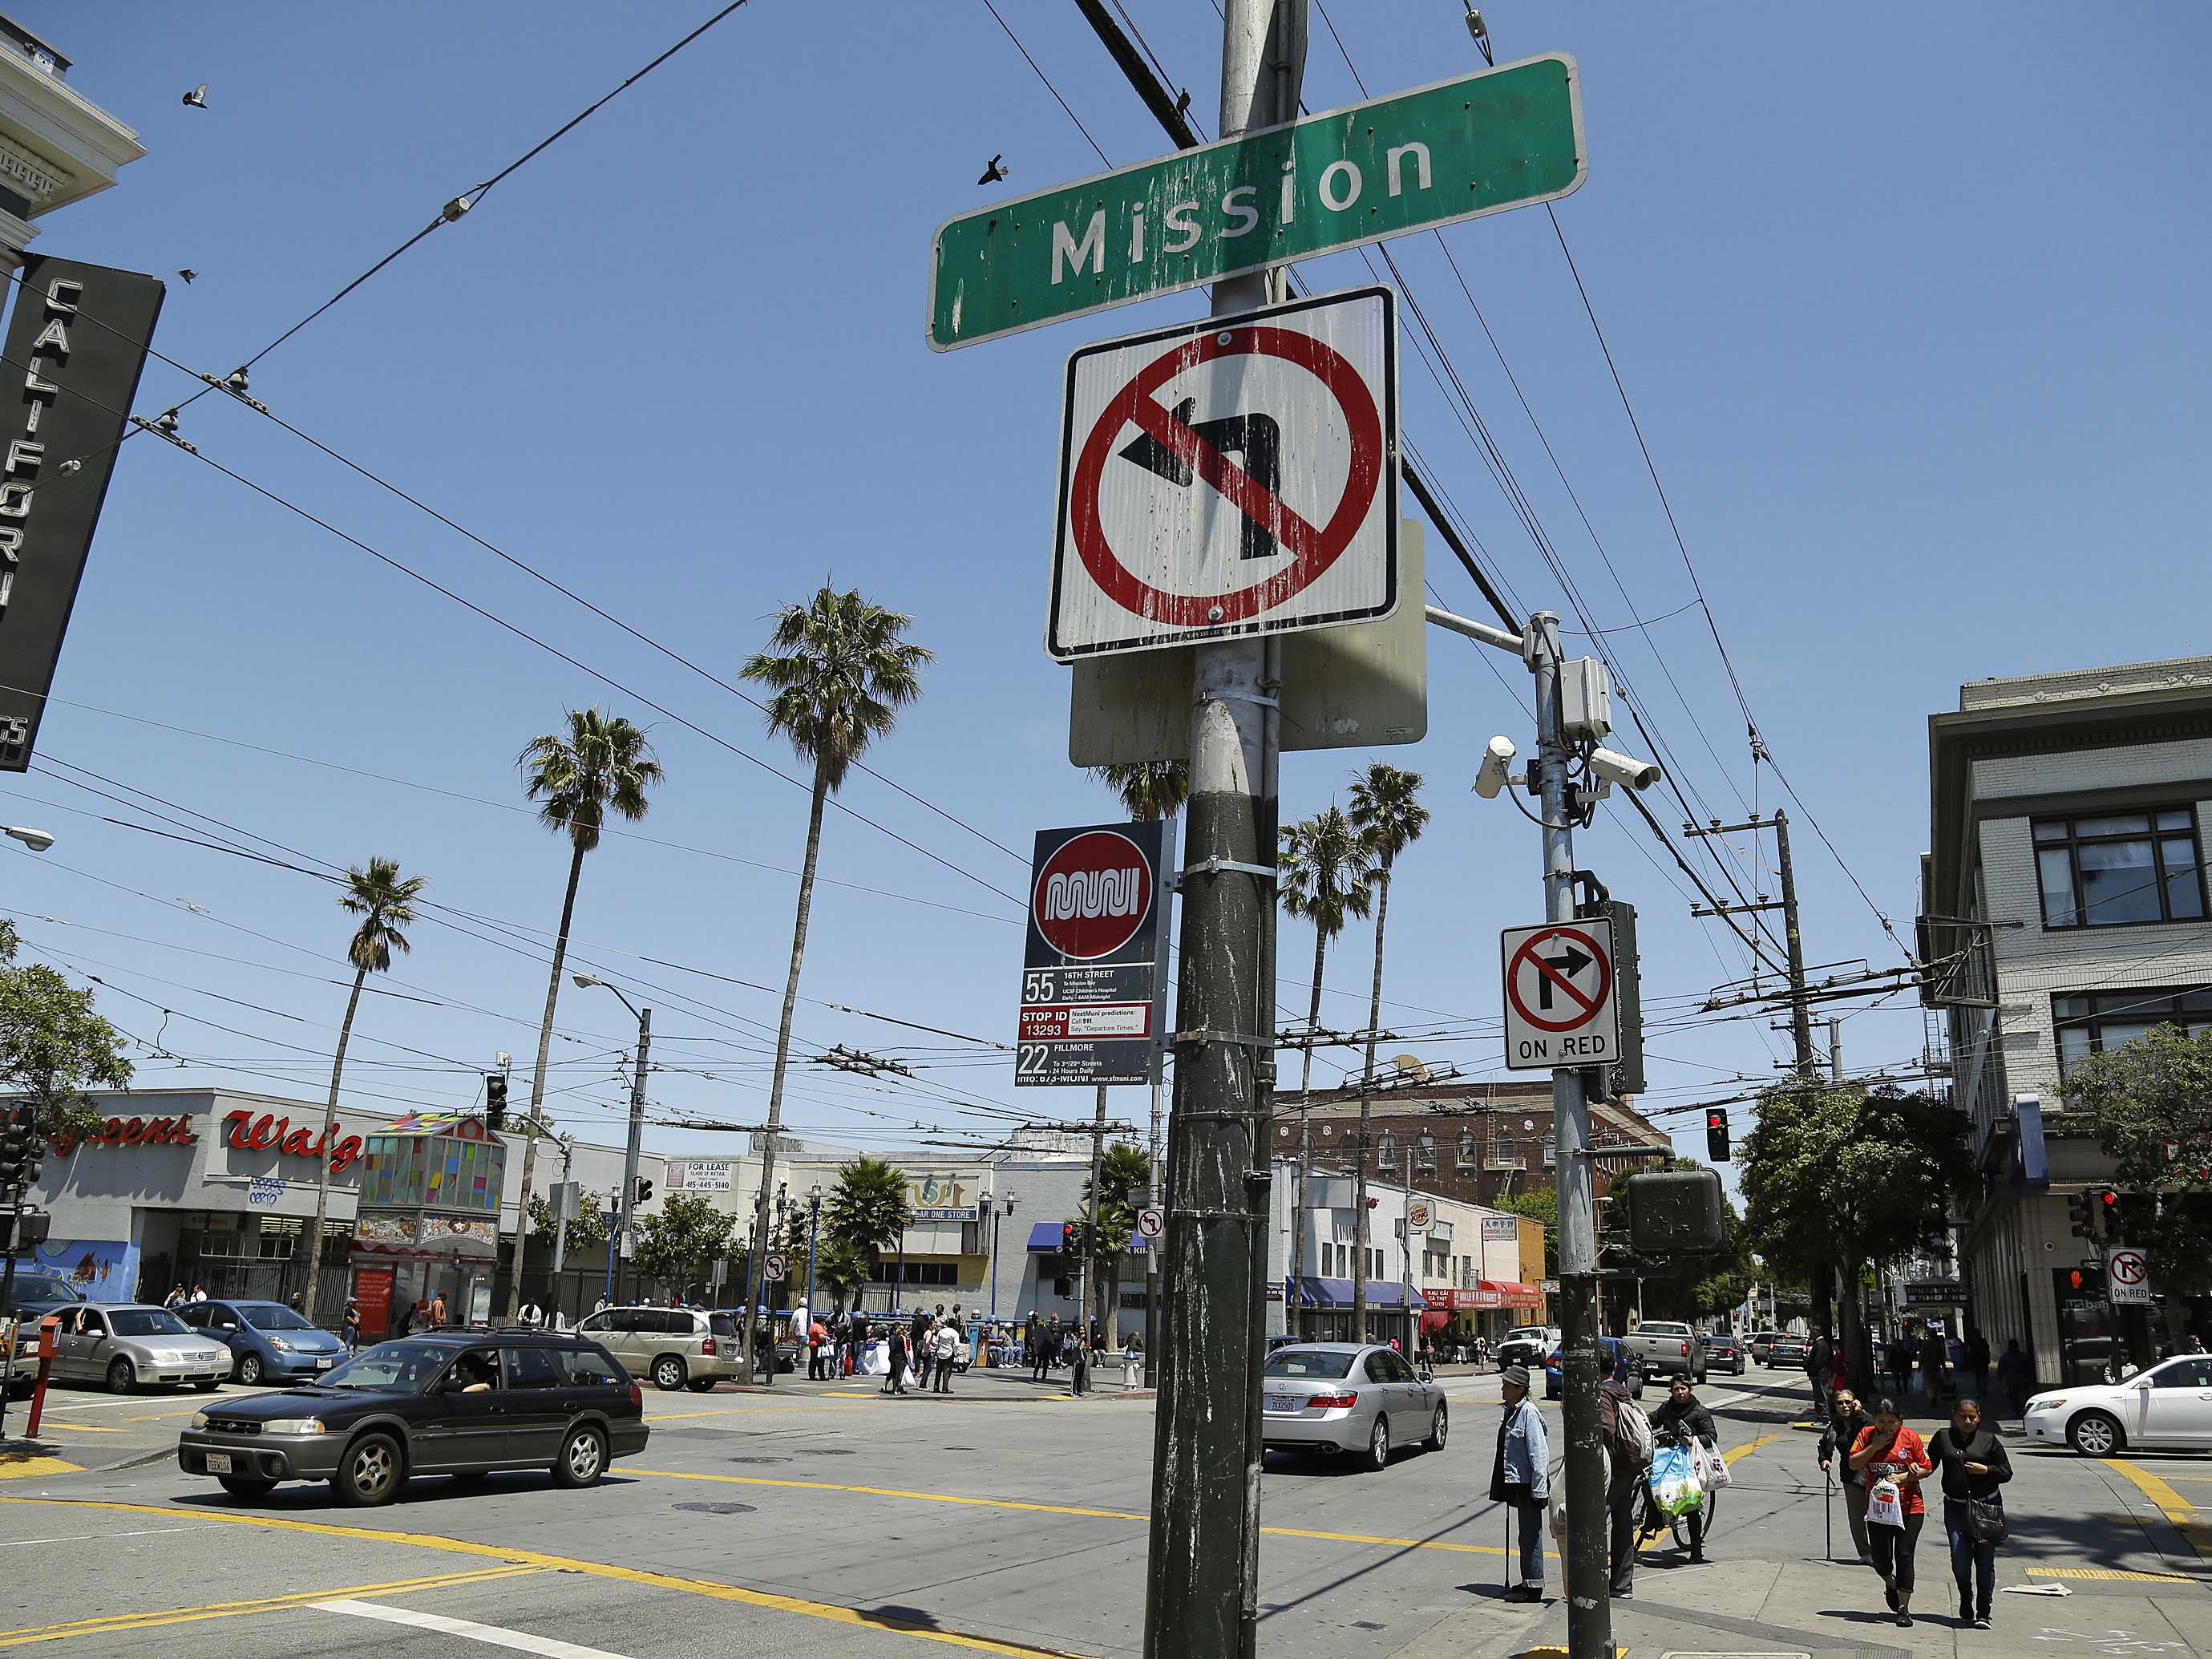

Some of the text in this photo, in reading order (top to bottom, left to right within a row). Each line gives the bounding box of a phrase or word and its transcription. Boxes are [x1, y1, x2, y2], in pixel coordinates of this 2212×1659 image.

[1050, 141, 1433, 285] Mission
[1045, 868, 1140, 921] MUNI
[1085, 970, 1114, 979] STREET
[1025, 973, 1055, 1001] 55
[1021, 1011, 1067, 1022] STOP ID
[1026, 1025, 1061, 1036] 13293
[1054, 1044, 1094, 1052] FILLMORE
[1519, 1035, 1605, 1059] ON RED
[1018, 1045, 1049, 1074] 22
[685, 1180, 730, 1188] 415-445-5140
[1410, 1208, 1428, 1216] BURGER
[1411, 1212, 1429, 1220] KING
[1134, 1246, 1150, 1254] KIN
[2114, 1289, 2147, 1298] ON RED
